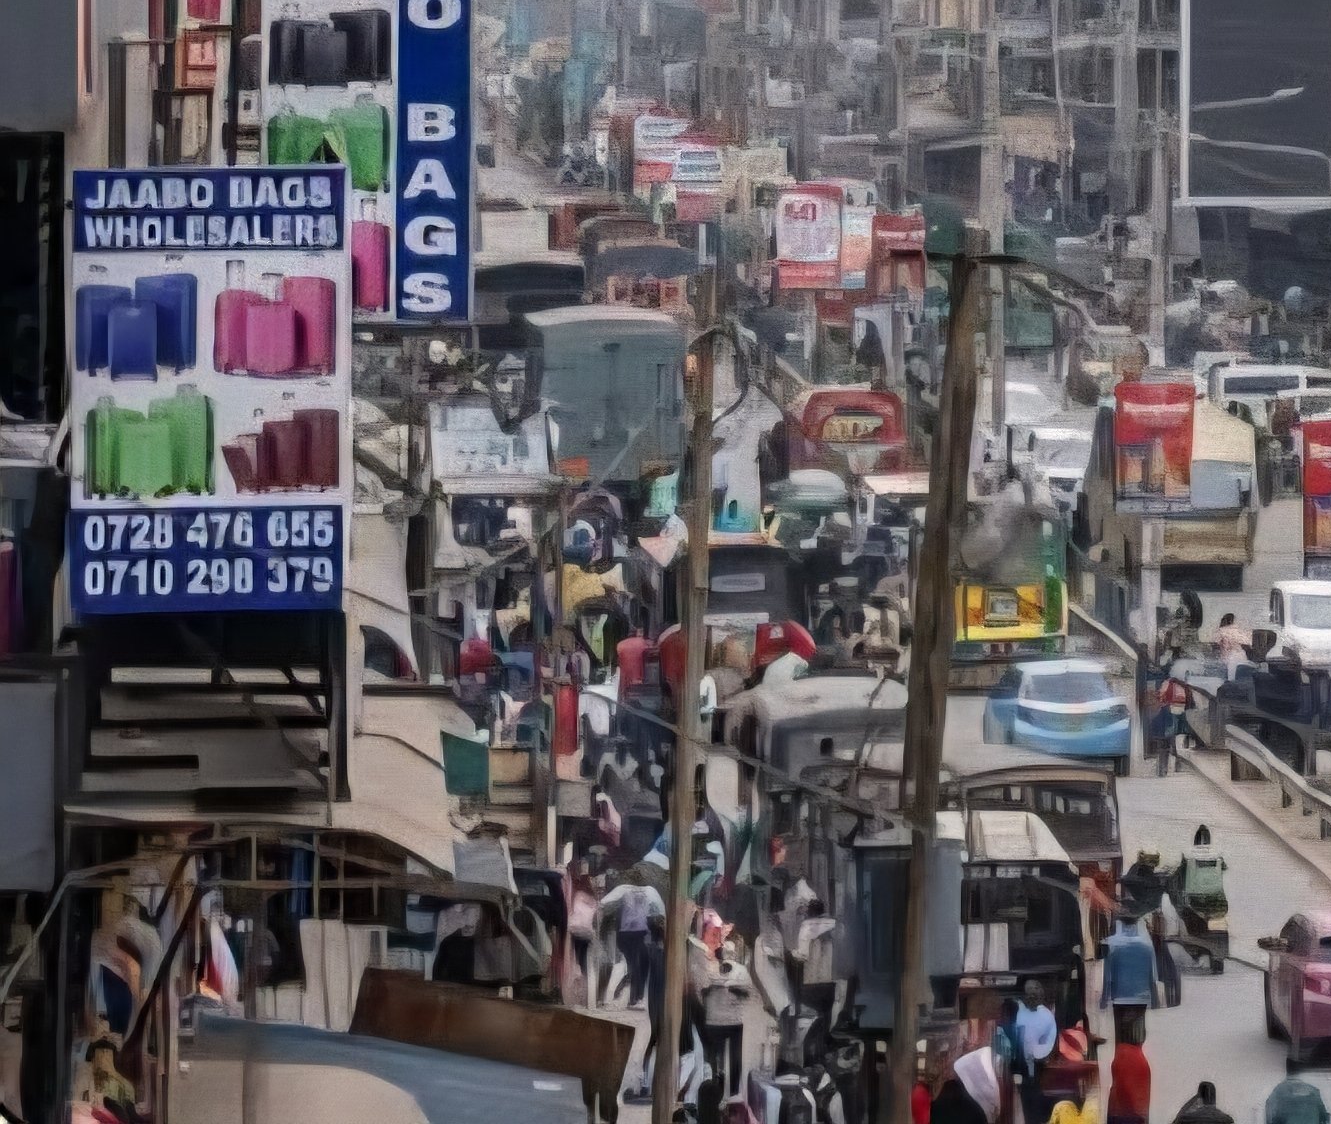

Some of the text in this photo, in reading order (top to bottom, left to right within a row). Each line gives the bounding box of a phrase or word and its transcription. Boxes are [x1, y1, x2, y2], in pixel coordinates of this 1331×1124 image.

[85, 177, 214, 209] JAABO
[403, 102, 459, 313] BAGS
[84, 559, 174, 596] 0710
